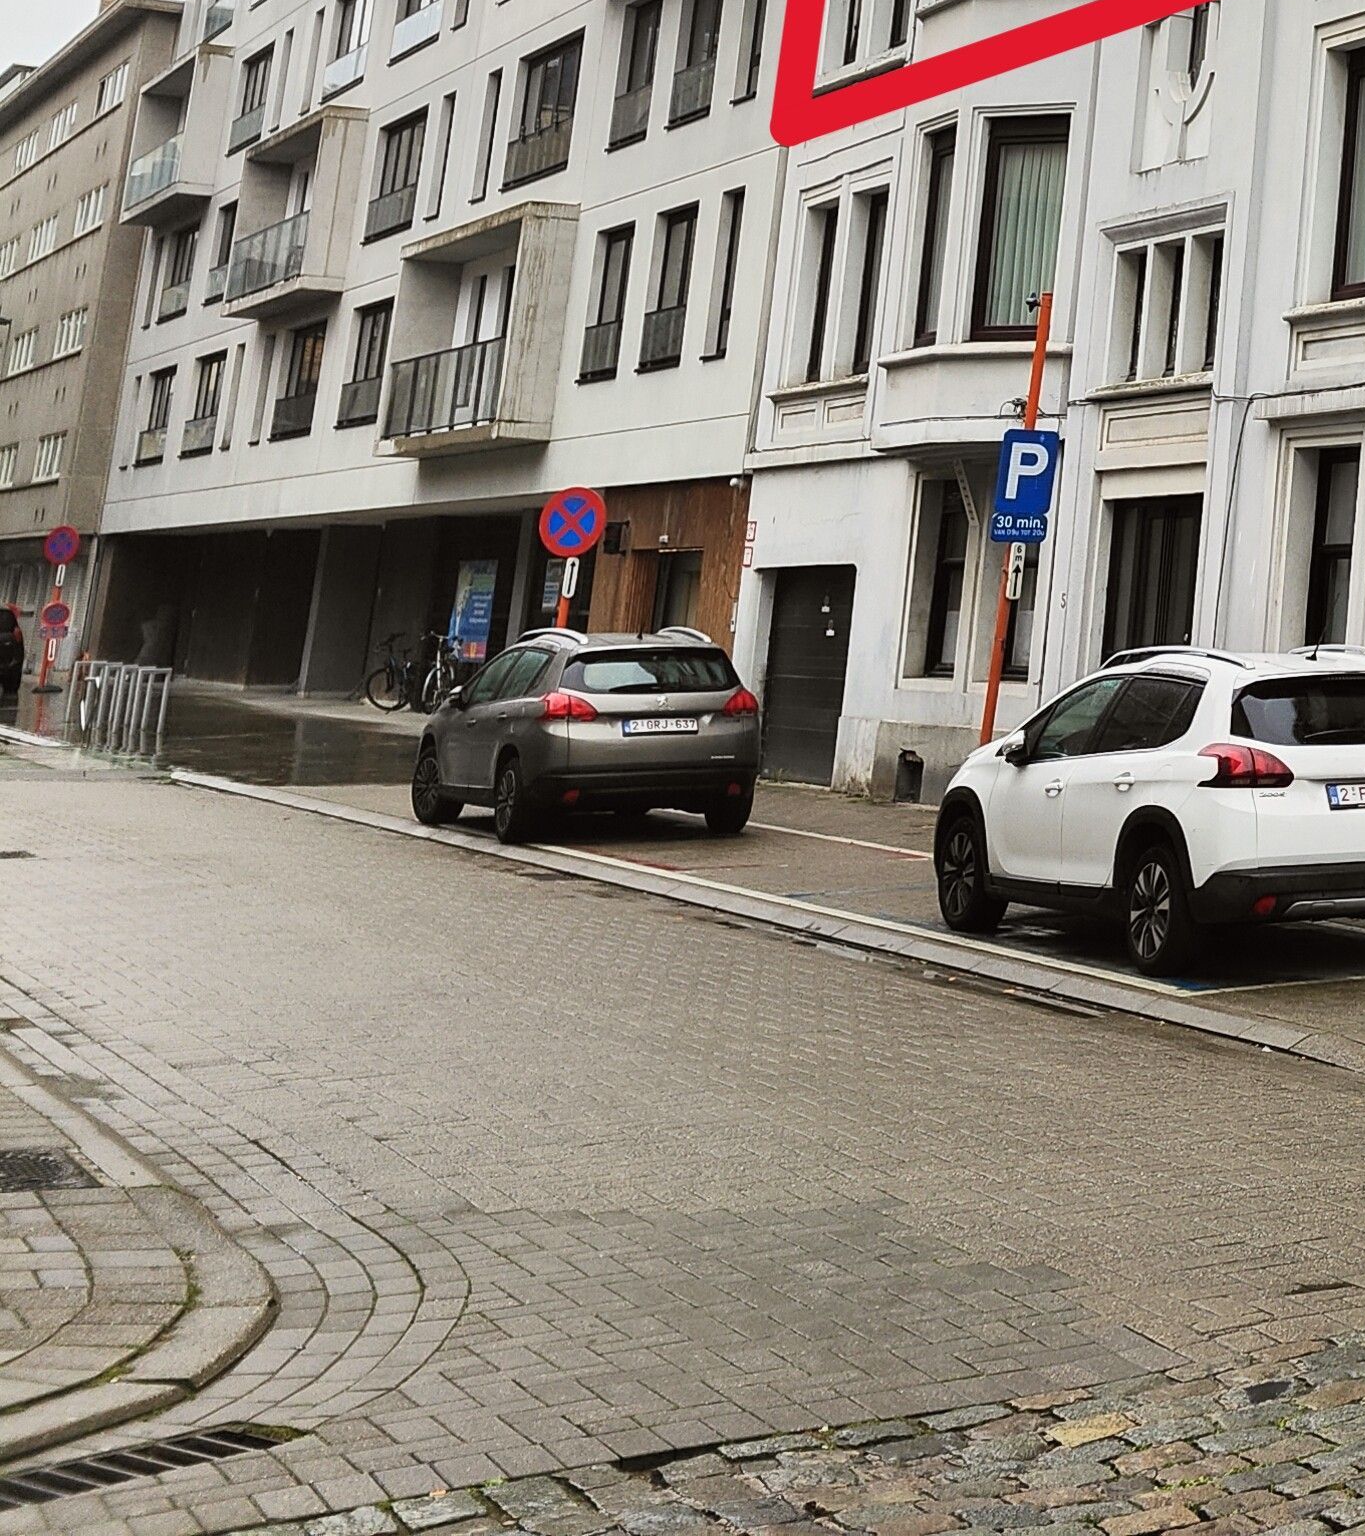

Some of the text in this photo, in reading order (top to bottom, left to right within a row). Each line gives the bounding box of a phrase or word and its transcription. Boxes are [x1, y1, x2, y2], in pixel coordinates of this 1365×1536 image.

[1005, 441, 1049, 500] P
[996, 515, 1044, 529] 30 min.
[1017, 545, 1022, 553] 6
[1060, 592, 1066, 609] 5
